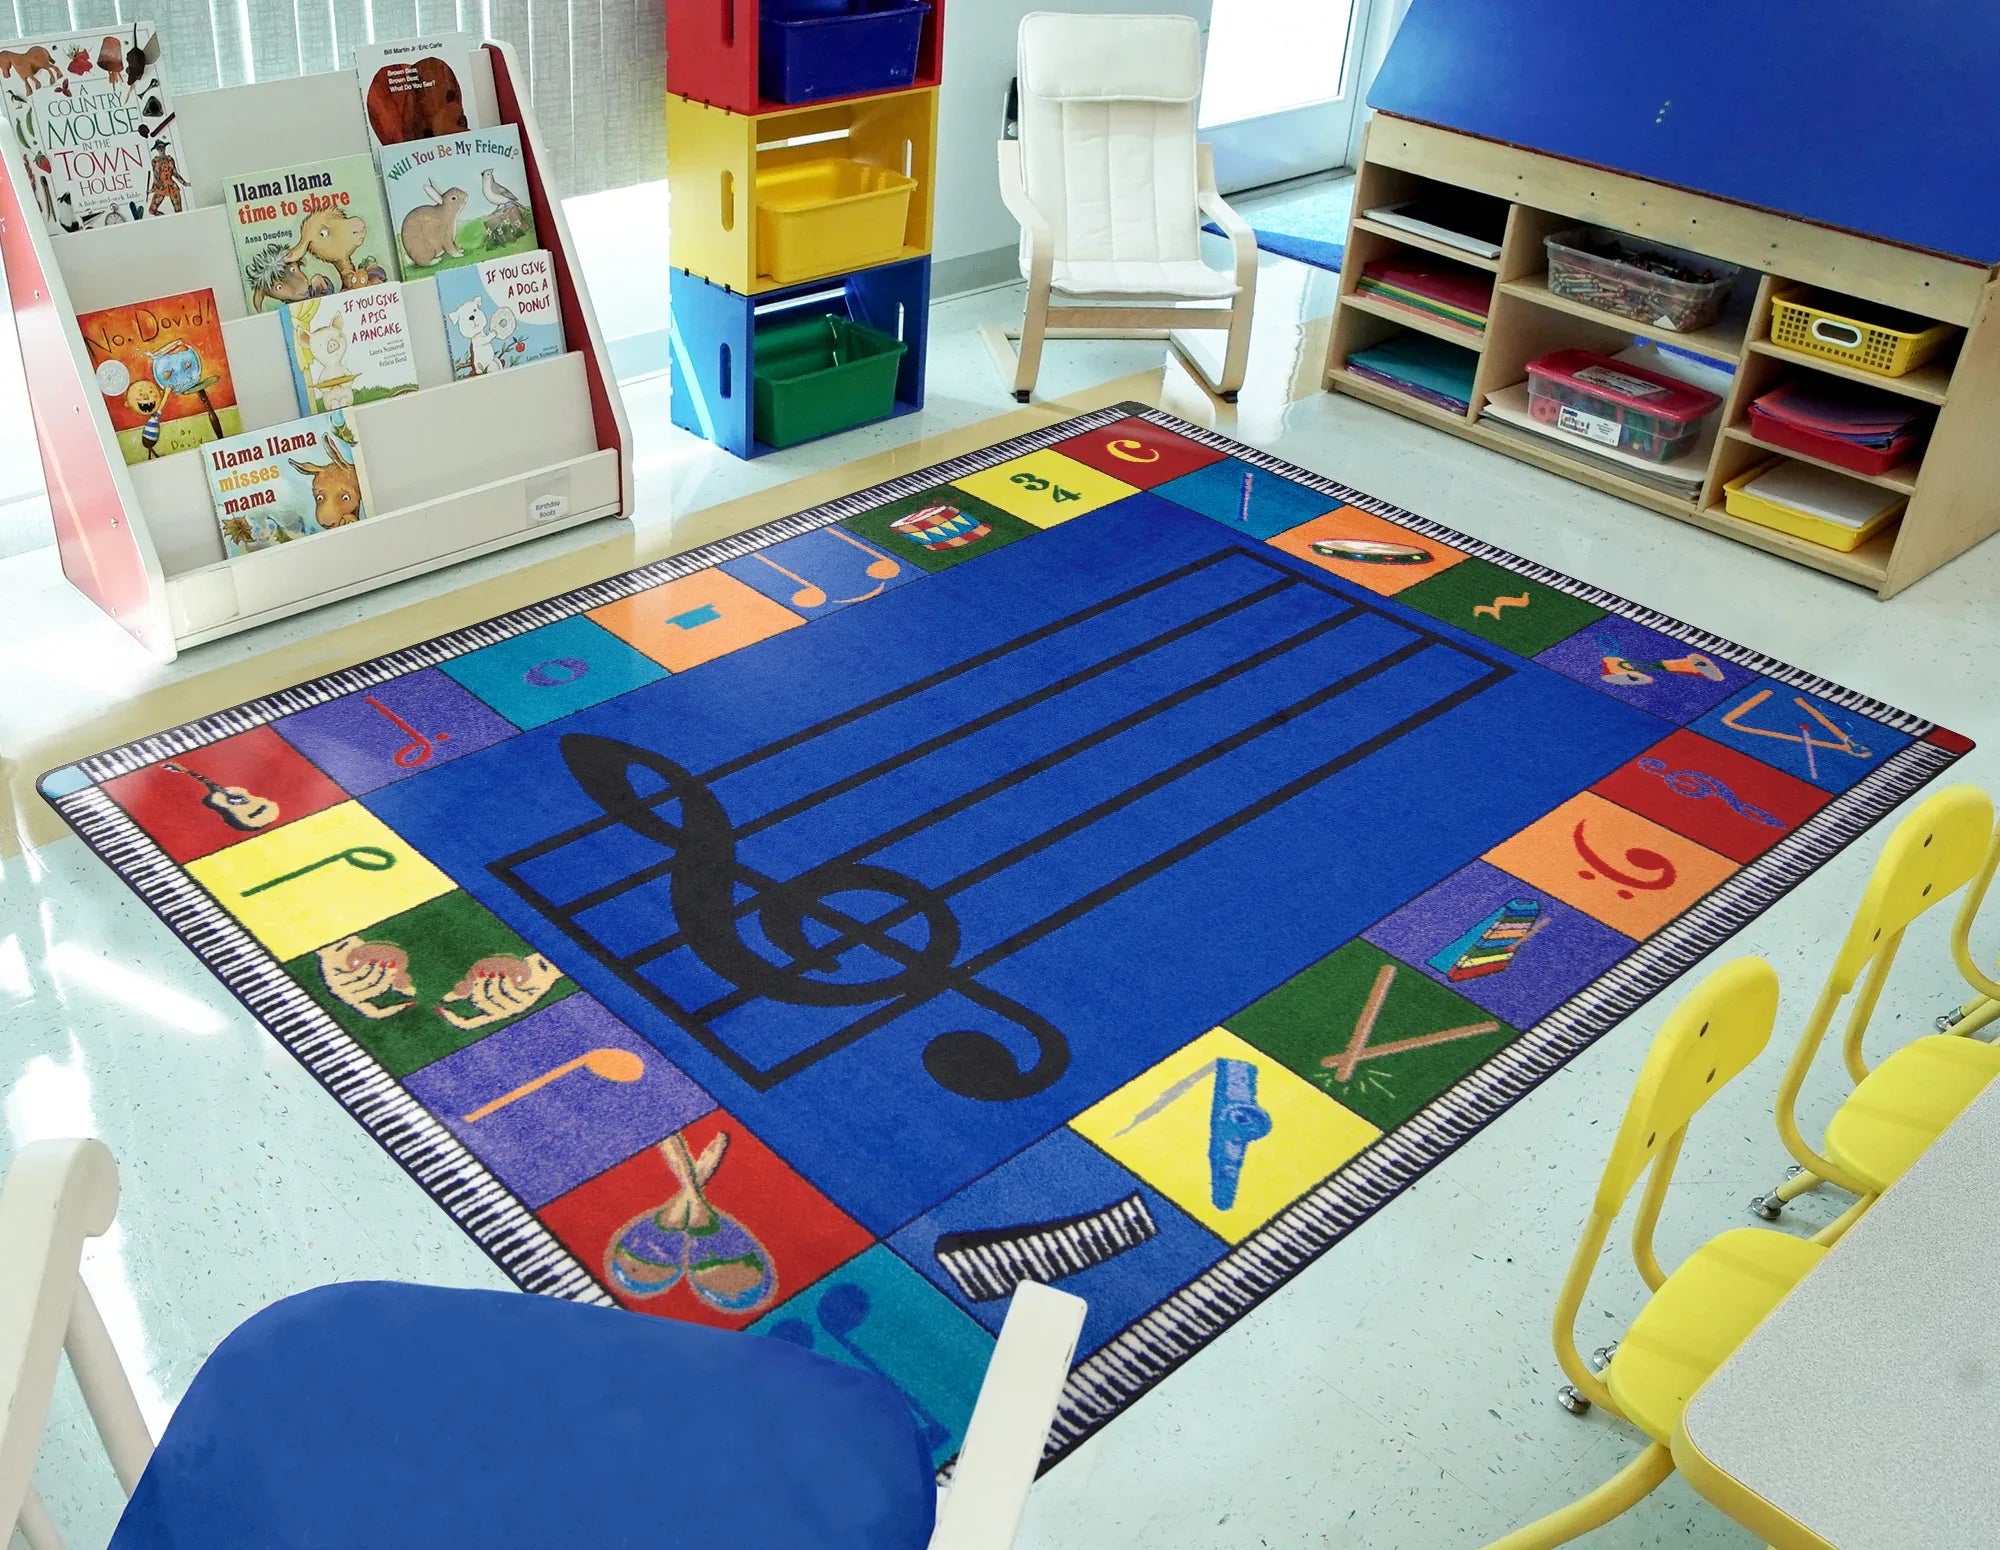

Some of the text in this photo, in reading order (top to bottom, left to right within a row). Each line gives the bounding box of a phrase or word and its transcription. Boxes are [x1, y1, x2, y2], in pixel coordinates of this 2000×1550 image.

[393, 46, 410, 54] Martin
[79, 84, 88, 96] A
[48, 92, 122, 117] COUNTRY
[47, 106, 139, 150] MOUSE
[82, 138, 112, 152] IN THE
[54, 144, 143, 182] TOWN
[387, 139, 519, 181] Will You Be My Friend?
[80, 172, 133, 197] HOUSE
[233, 172, 333, 203] llama llama
[238, 191, 351, 225] time to share
[245, 236, 262, 245] Anna
[486, 260, 547, 284] IF YOU GIVE
[508, 278, 548, 299] A DOG A
[343, 292, 400, 313] IF YOU GIVE
[518, 294, 551, 315] DONUT
[361, 309, 387, 326] A PIG
[84, 327, 132, 361] No,
[351, 322, 402, 344] A PANCAKE
[211, 431, 317, 471] llama llama
[218, 464, 280, 493] misses
[223, 489, 277, 515] mama
